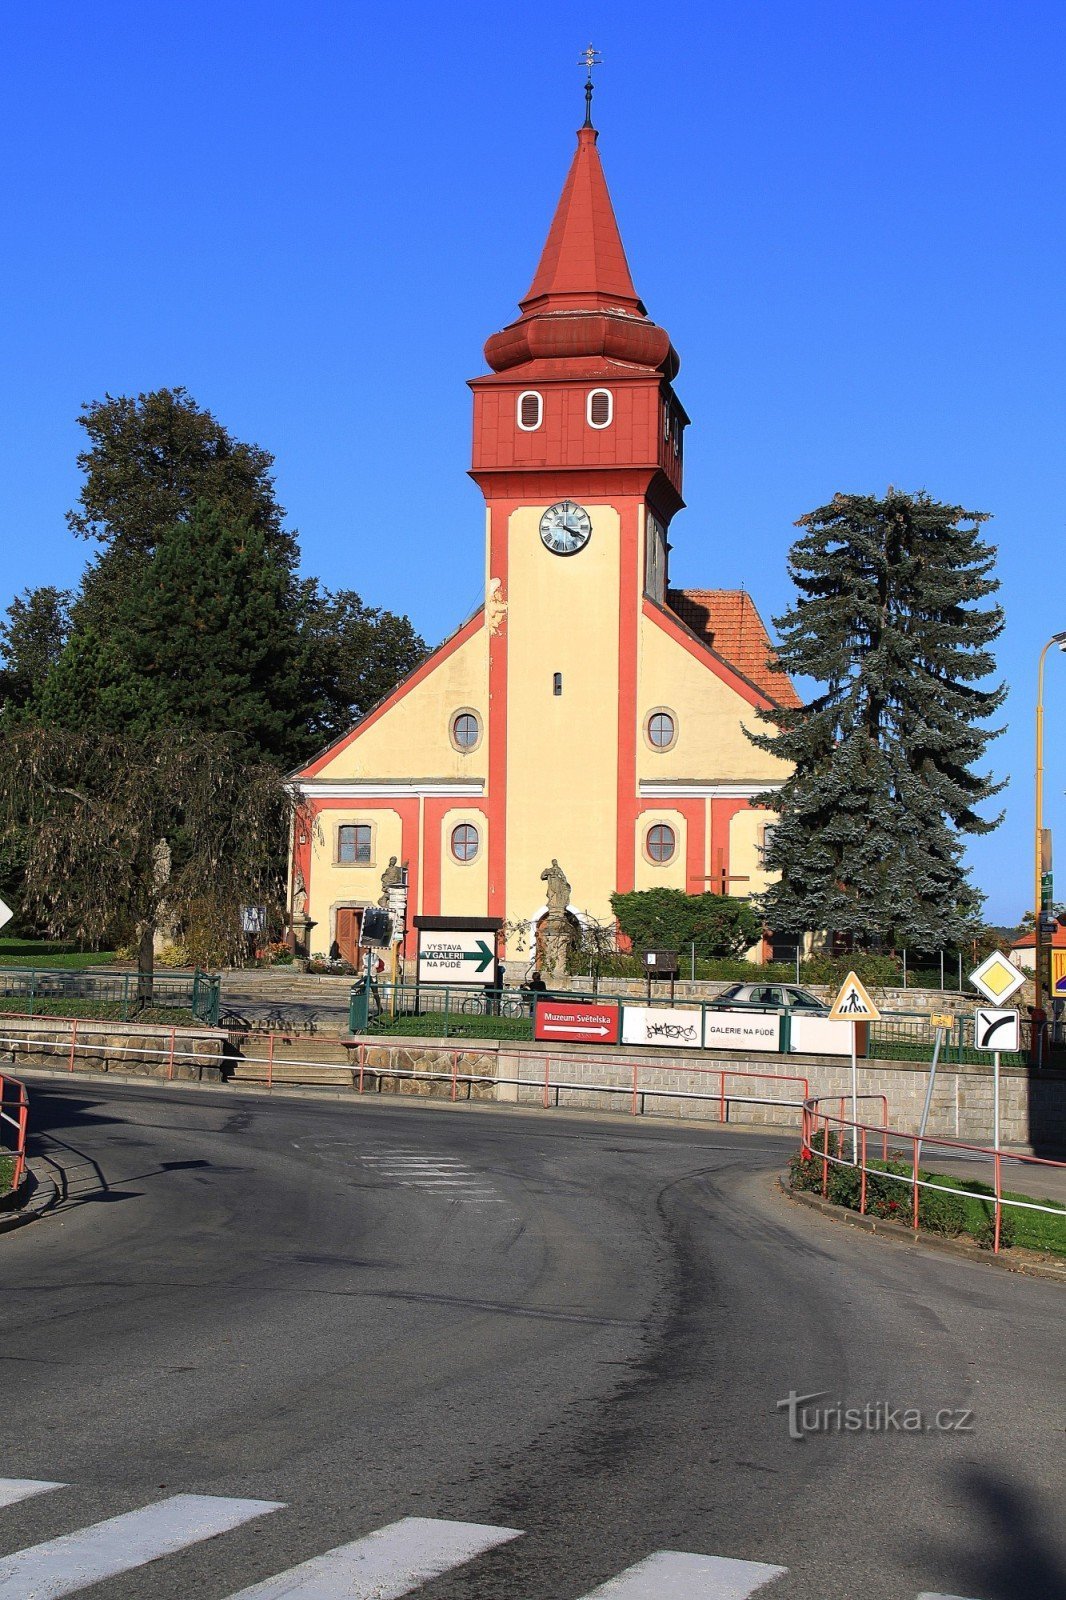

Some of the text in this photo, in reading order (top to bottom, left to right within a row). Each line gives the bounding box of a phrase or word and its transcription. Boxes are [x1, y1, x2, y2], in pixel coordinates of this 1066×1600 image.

[427, 943, 462, 951] VYSTAVA
[432, 952, 464, 960] GALERII
[544, 1013, 611, 1024] Muzeum Světelska
[710, 1026, 741, 1035] GALERIE
